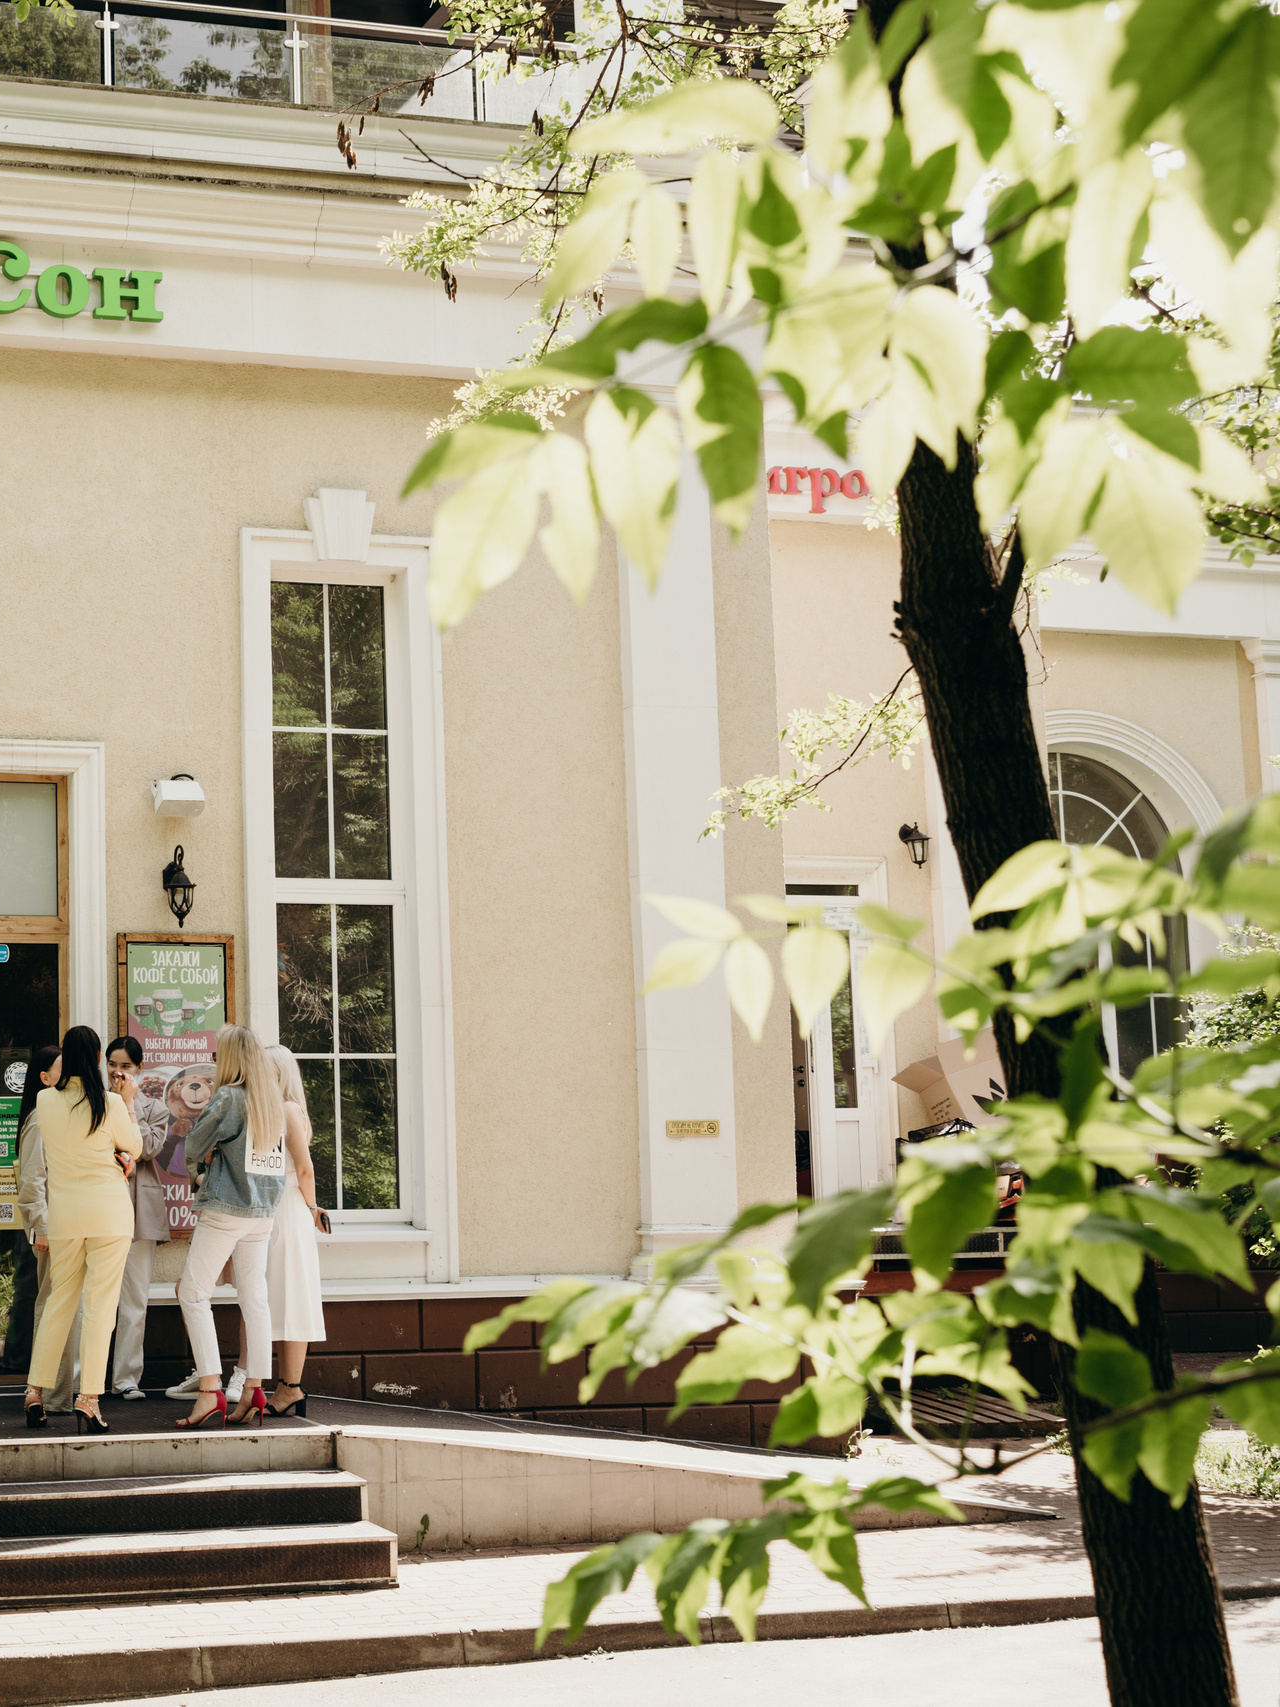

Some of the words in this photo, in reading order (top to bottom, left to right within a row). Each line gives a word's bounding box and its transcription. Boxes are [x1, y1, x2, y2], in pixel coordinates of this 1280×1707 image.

[152, 950, 200, 967] ЗАКАЖИ
[133, 967, 166, 984] КОФЕ
[169, 968, 178, 984] С
[180, 965, 219, 984] СОБОЙ
[145, 1038, 171, 1050] ВЫБЕРИ
[172, 1036, 208, 1050] ЛЮБИМЫЙ
[154, 1052, 181, 1063] СЭНДВИЧ
[182, 1052, 195, 1062] ИЛИ
[165, 1205, 198, 1227] 0%
